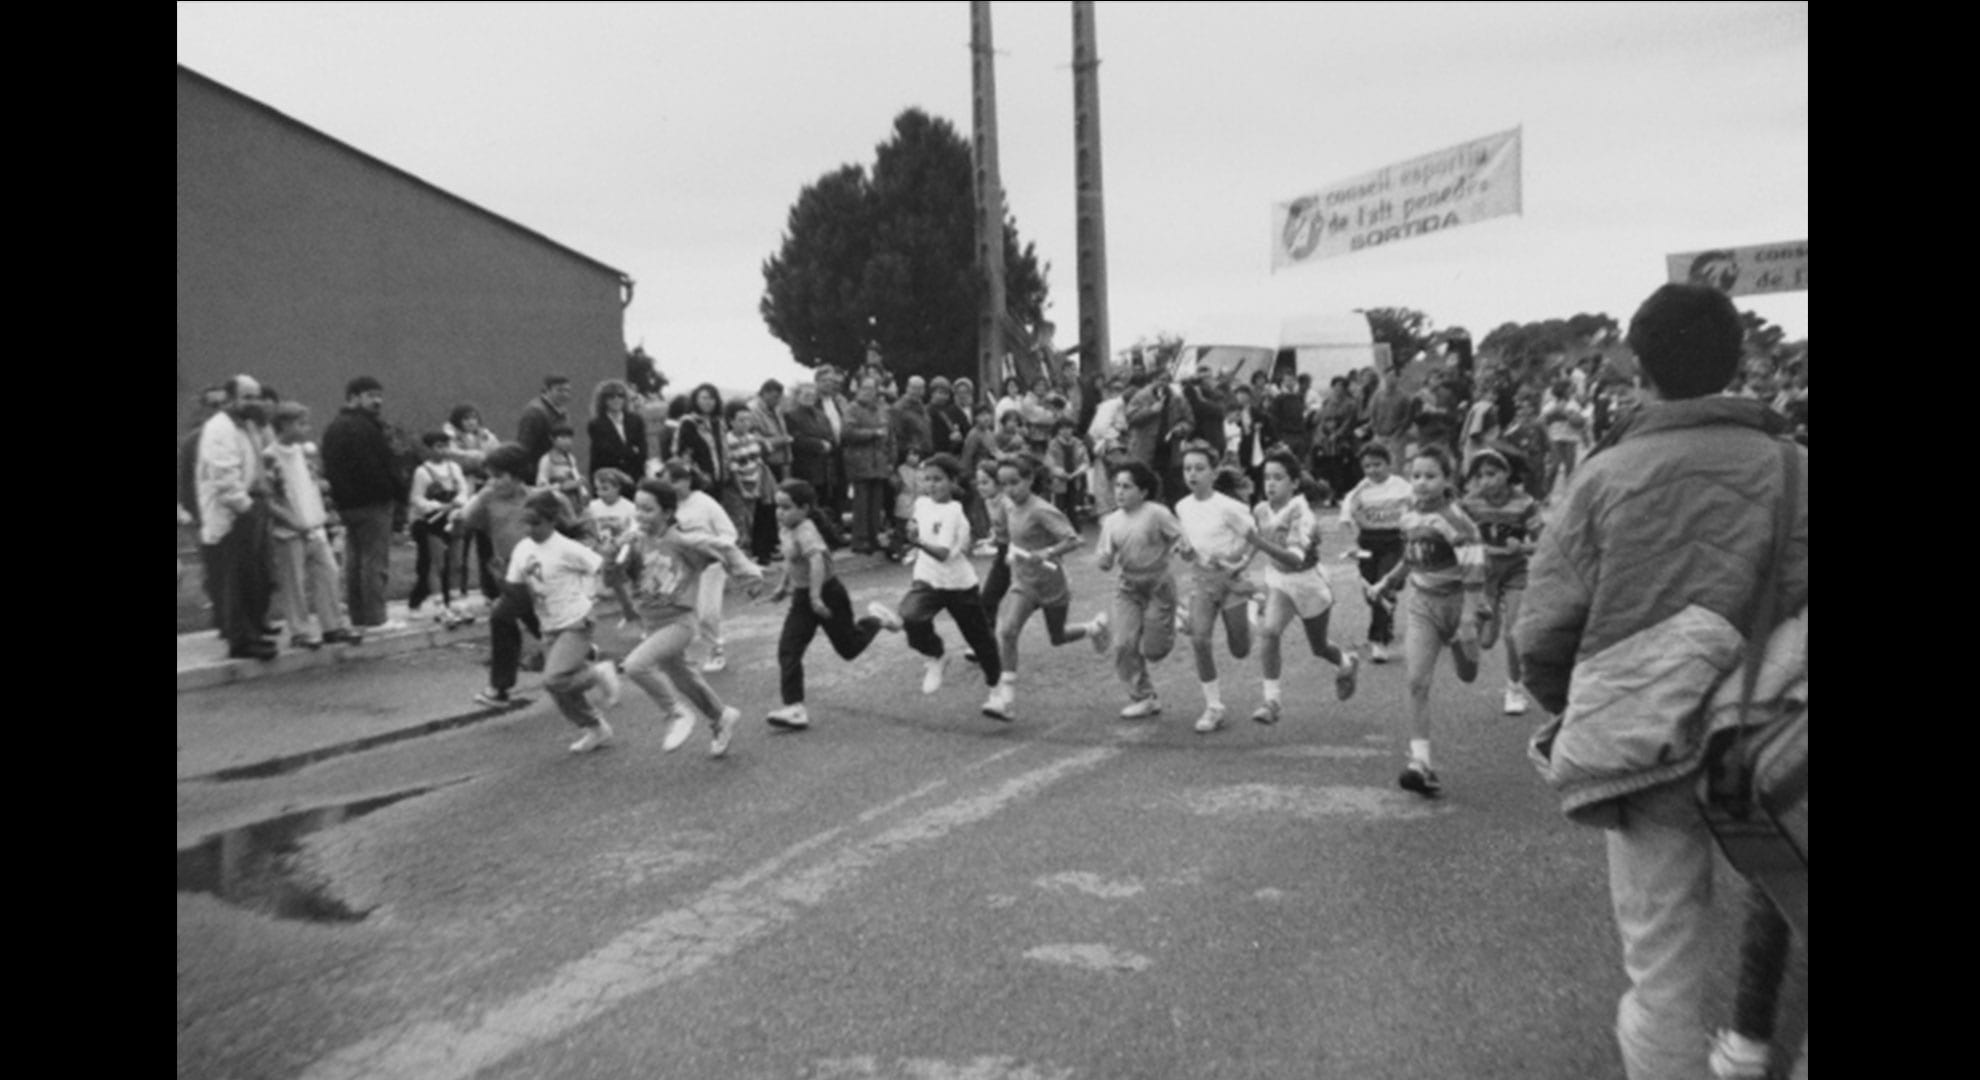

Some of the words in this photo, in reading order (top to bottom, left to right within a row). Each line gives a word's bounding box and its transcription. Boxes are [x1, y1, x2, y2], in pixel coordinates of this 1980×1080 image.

[1329, 212, 1348, 235] de
[1351, 210, 1460, 251] SORTIDA
[1755, 246, 1807, 263] cons
[1755, 270, 1784, 289] de
